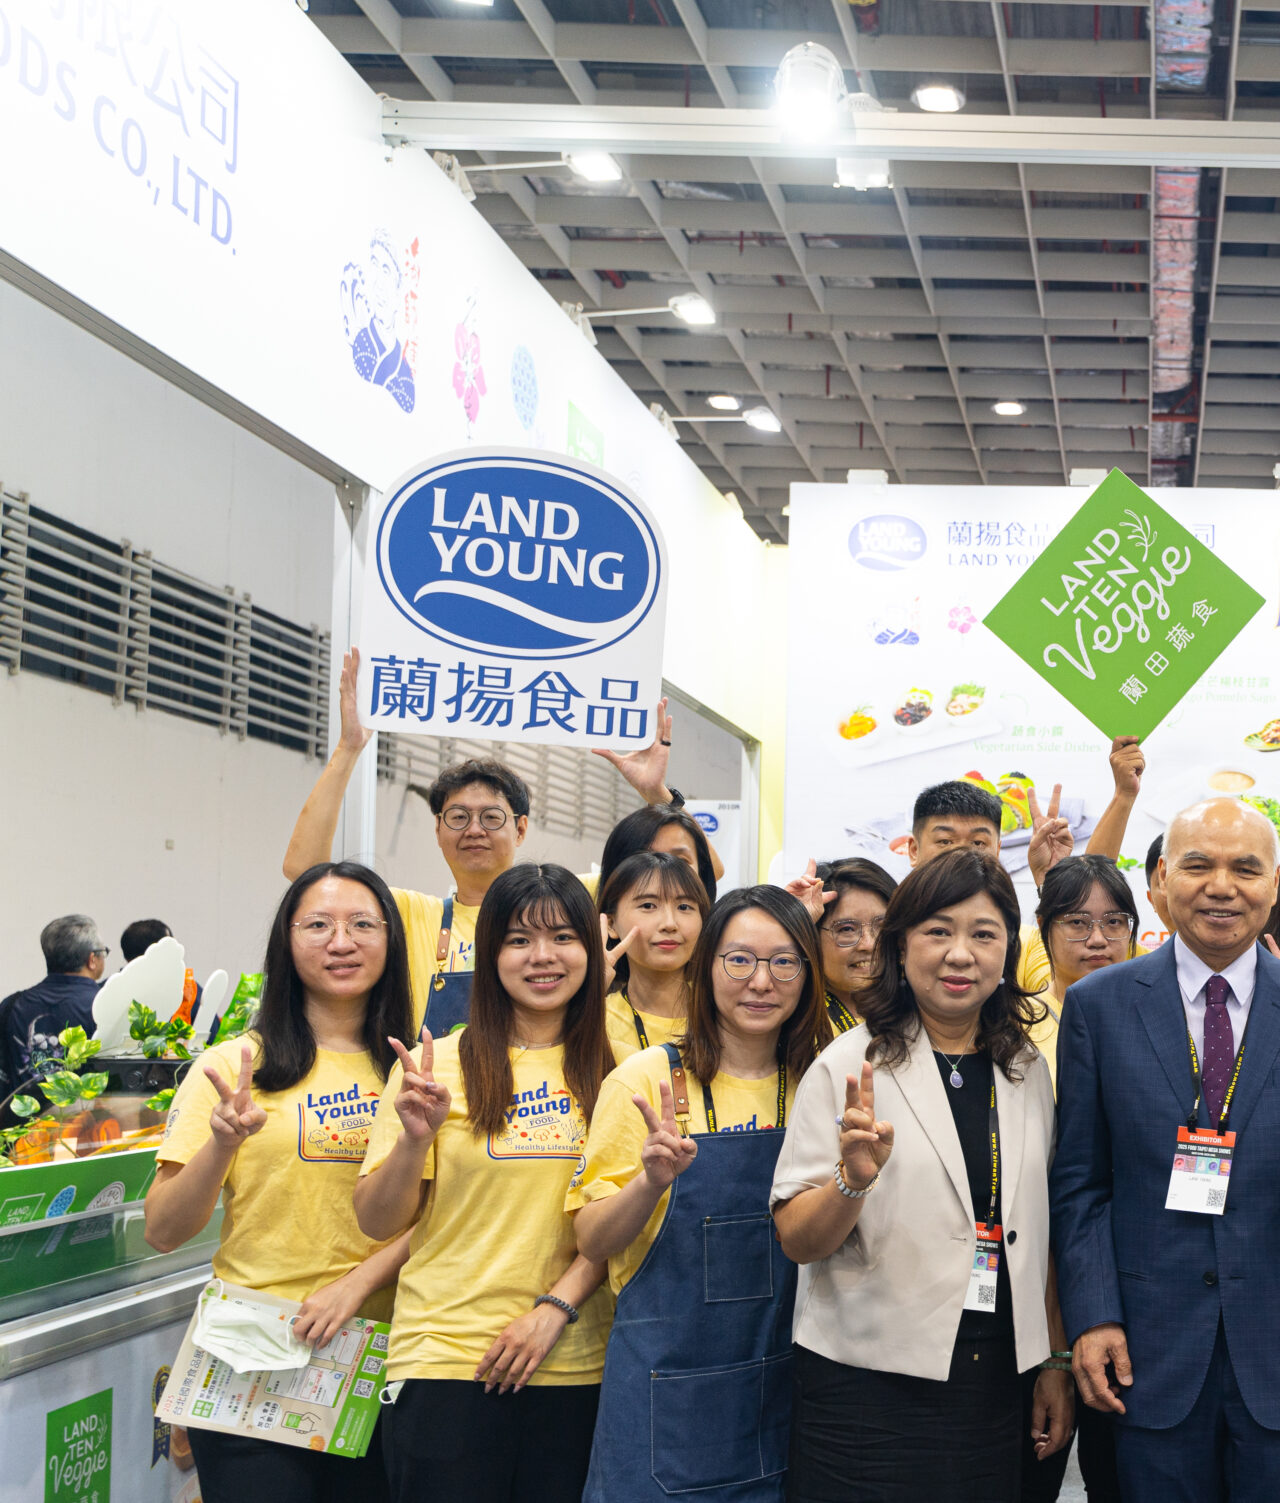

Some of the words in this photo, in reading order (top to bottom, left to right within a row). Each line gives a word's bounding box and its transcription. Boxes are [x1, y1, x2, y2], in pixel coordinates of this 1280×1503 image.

[92, 94, 160, 206] CO.,
[171, 153, 237, 256] LTD.
[431, 487, 580, 541] LAND
[428, 531, 625, 591] YOUNG
[948, 553, 998, 566] LAND
[1040, 528, 1121, 617] LAND
[1072, 555, 1140, 621] TEN
[1043, 545, 1192, 680] Veggie
[1118, 598, 1219, 705] 蘭田蔬食
[370, 654, 648, 739] 蘭揚食品
[973, 741, 1034, 753] Vegetarian
[1037, 741, 1061, 752] Side
[1064, 741, 1101, 752] Dishes
[306, 1083, 360, 1109] Land
[340, 1117, 366, 1129] FOOD
[528, 1116, 555, 1127] FOOD
[324, 1147, 354, 1157] Healthy
[514, 1143, 545, 1152] Healthy
[547, 1143, 580, 1152] Lifestyle
[1189, 1134, 1223, 1145] EXHIBITOR
[63, 1414, 98, 1443] LAND
[69, 1436, 94, 1461] TEN
[49, 1450, 108, 1494] Veggie
